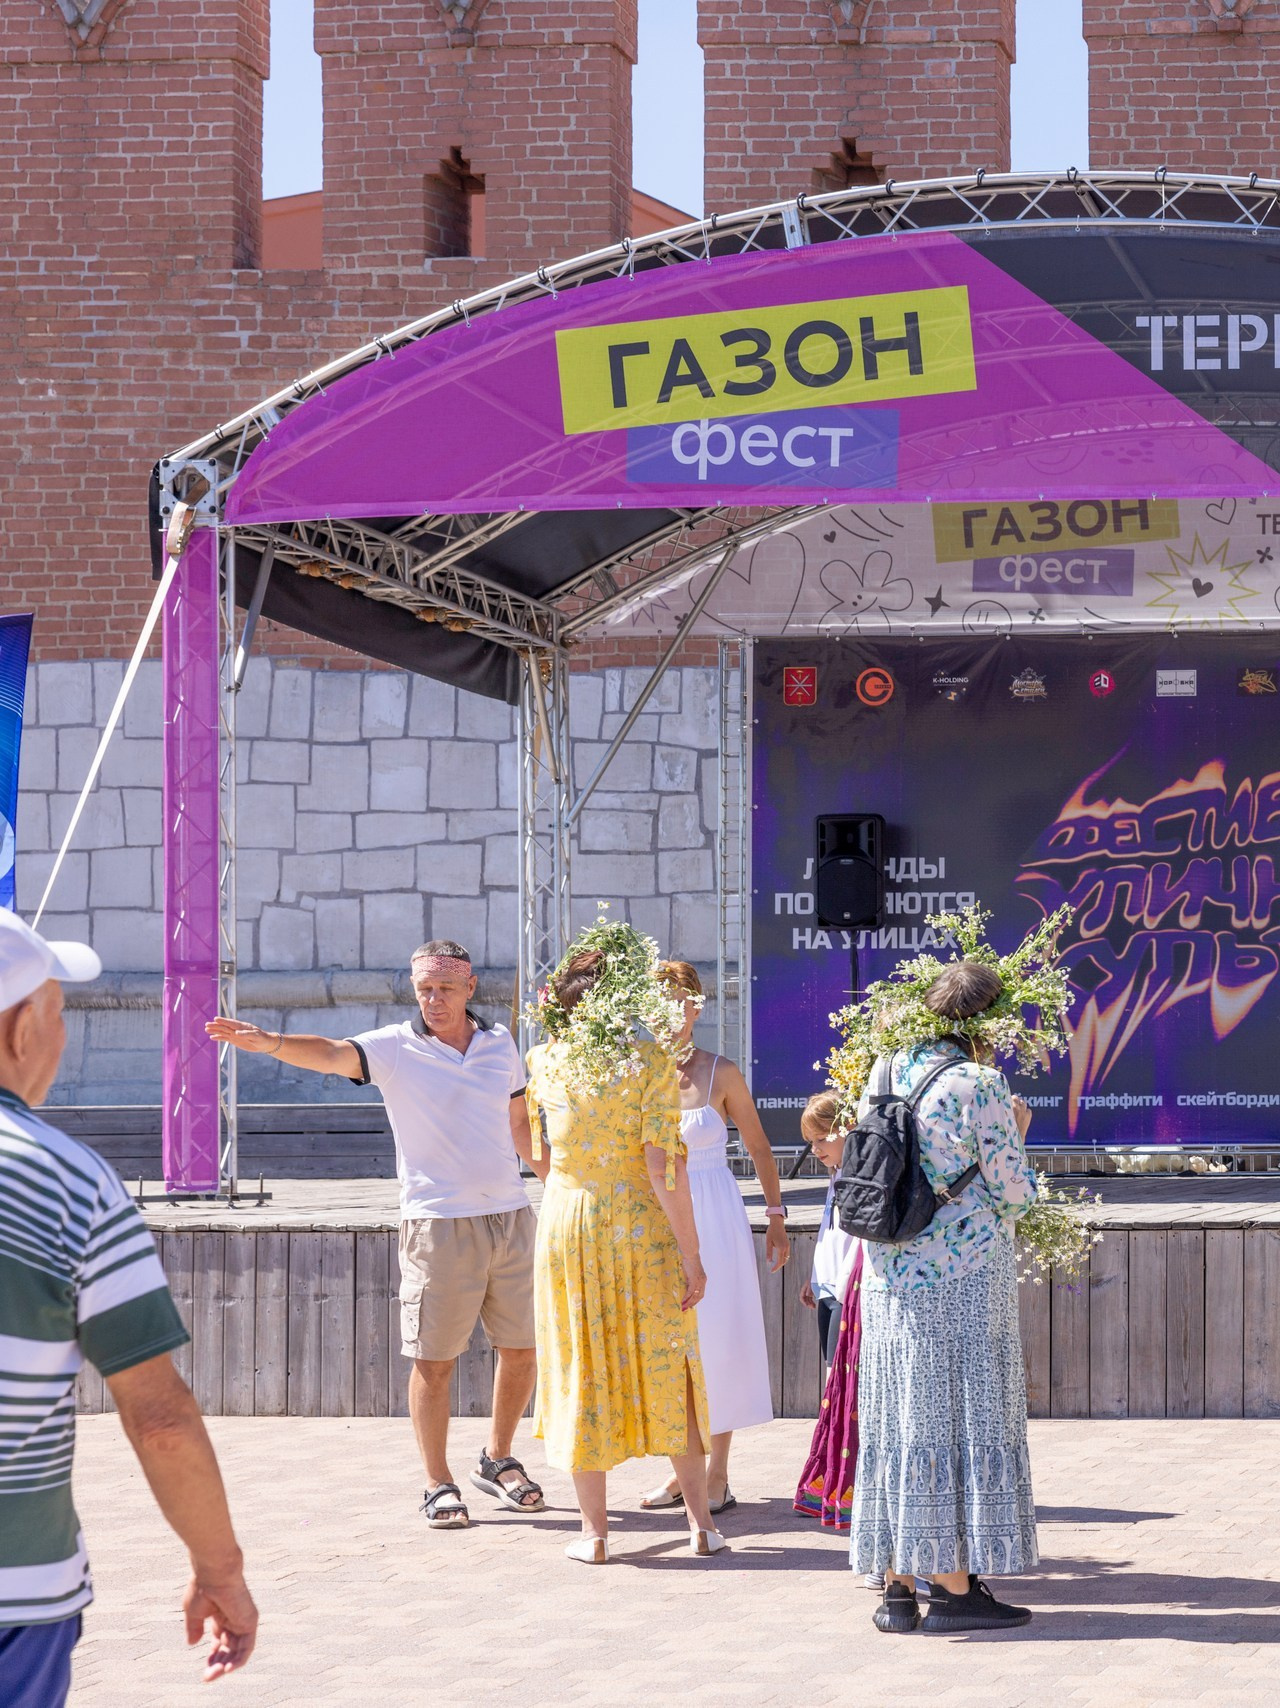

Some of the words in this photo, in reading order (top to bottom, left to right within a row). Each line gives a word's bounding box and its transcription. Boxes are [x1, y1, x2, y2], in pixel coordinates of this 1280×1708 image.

[608, 311, 924, 409] ГАЗОН
[671, 418, 854, 480] фест
[962, 499, 1149, 548] ГАЗОН
[998, 554, 1108, 591] фест
[774, 891, 976, 915] ПОЮТСЯ
[792, 927, 833, 950] НА
[1076, 1092, 1163, 1110] граффити
